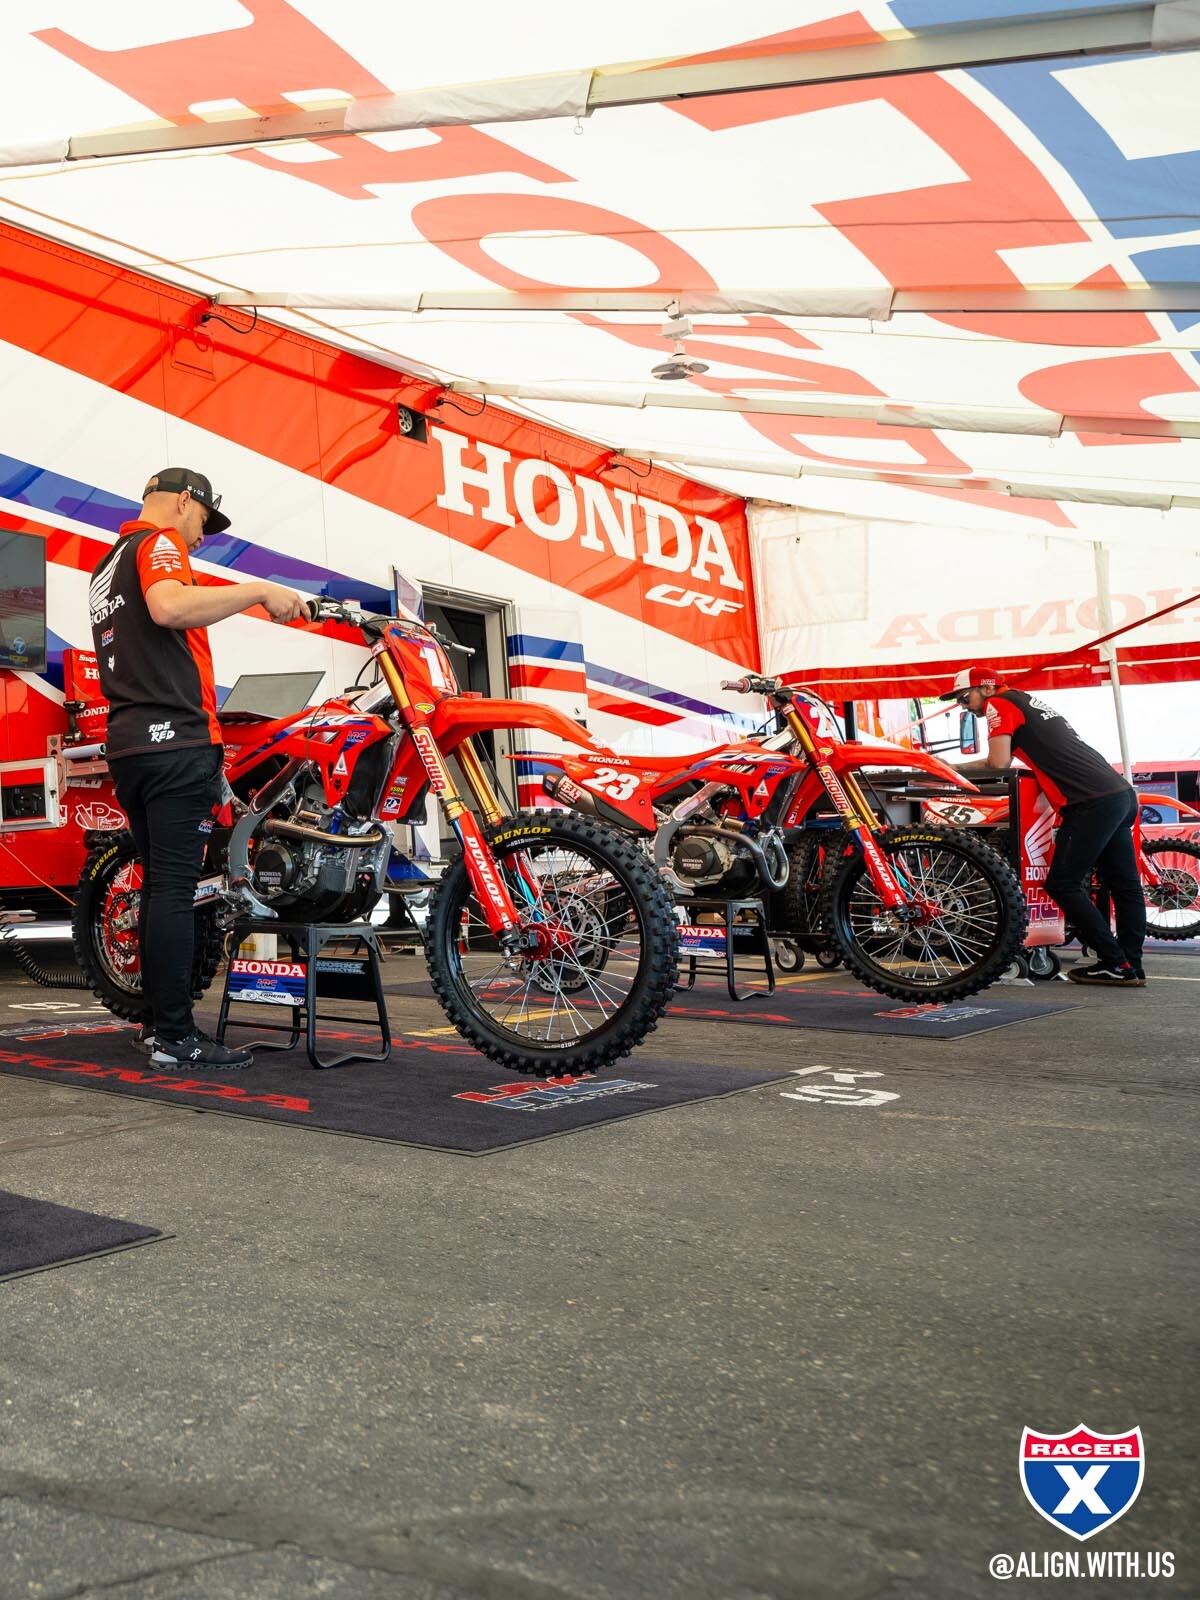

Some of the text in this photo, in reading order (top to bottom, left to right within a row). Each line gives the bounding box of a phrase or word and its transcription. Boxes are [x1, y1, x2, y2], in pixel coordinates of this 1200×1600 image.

[431, 425, 745, 591] HONDA
[645, 583, 745, 617] CRF
[151, 729, 176, 743] RED
[413, 733, 448, 792] SHOWA
[587, 755, 631, 766] HONDA
[581, 767, 640, 800] 23
[820, 770, 850, 812] SHOWA
[939, 796, 972, 804] HONDA
[939, 804, 976, 824] 45
[493, 826, 552, 846] DUNLOP
[893, 833, 943, 844] DUNLOP
[90, 845, 119, 879] DUNLOP
[464, 835, 505, 908] DUNLOP
[862, 840, 895, 891] DUNLOP
[1025, 866, 1050, 882] HON
[676, 926, 726, 938] ONDA
[232, 959, 305, 978] HONDA
